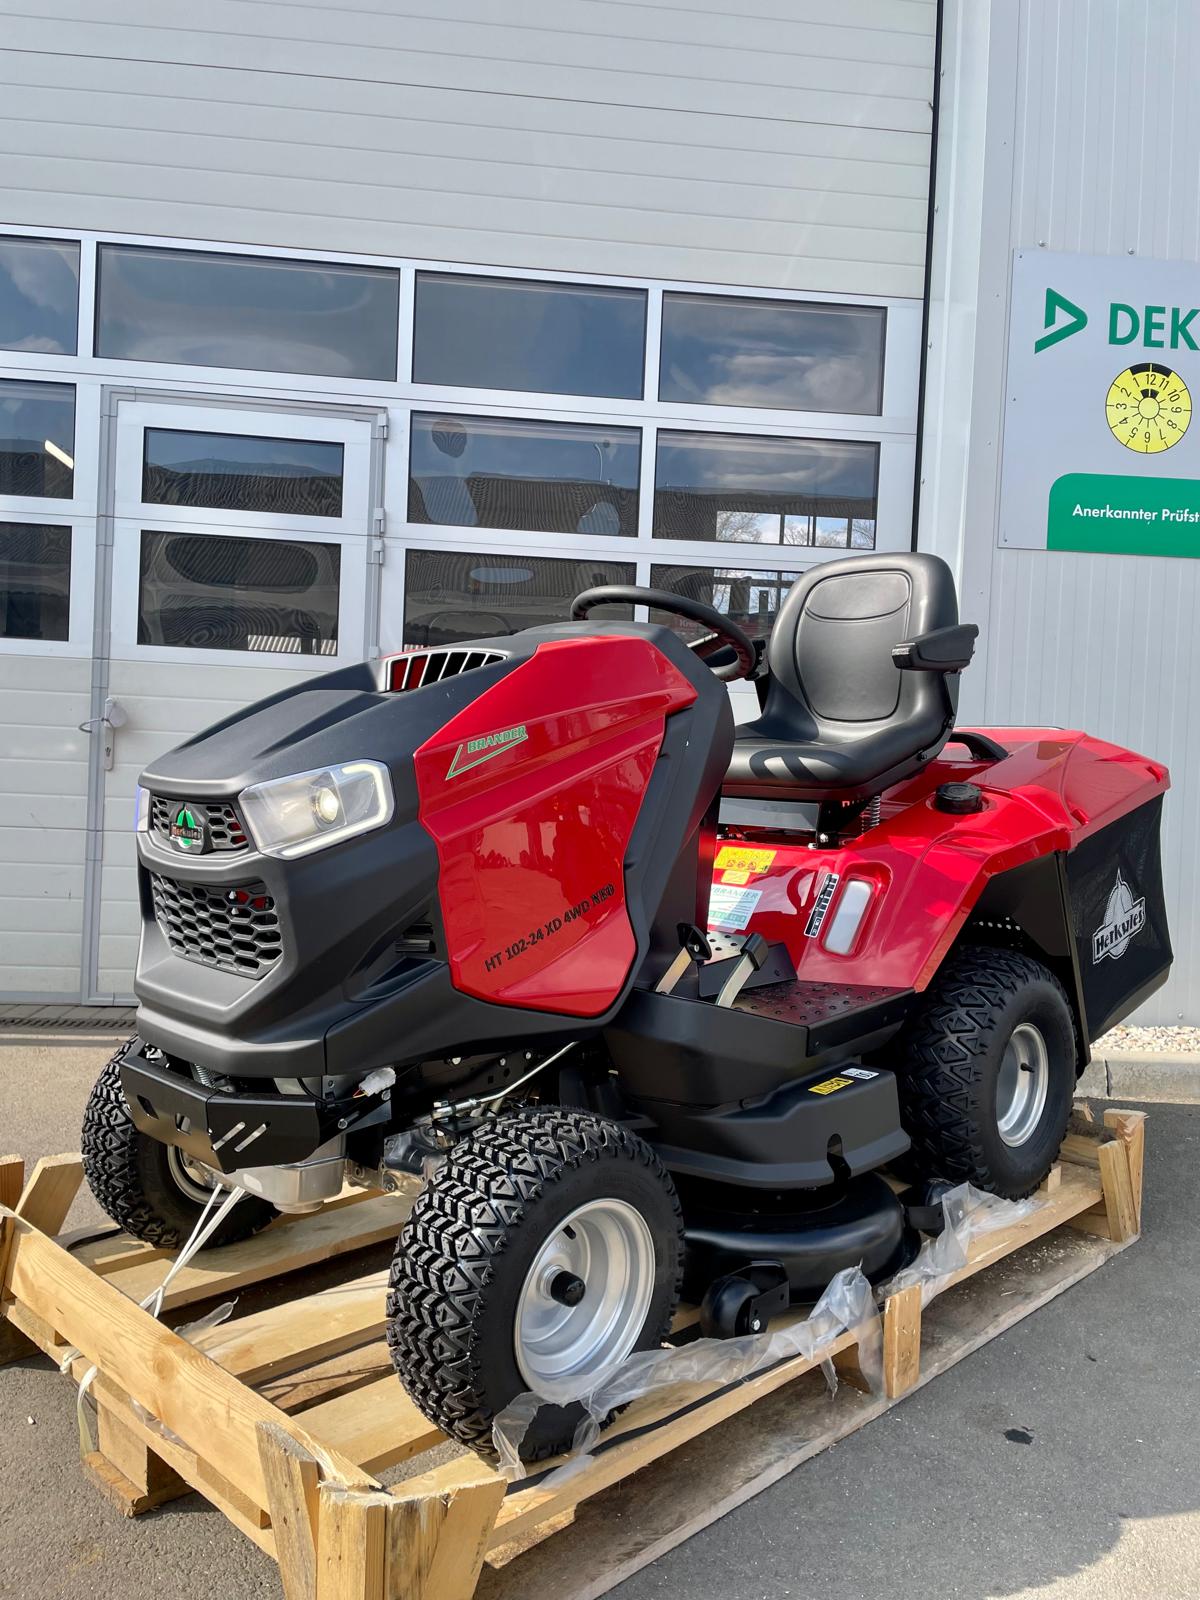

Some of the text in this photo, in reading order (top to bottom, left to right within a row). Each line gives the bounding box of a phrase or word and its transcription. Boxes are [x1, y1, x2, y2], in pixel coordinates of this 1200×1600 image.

[1108, 302, 1200, 351] DEK
[1132, 376, 1140, 388] 1
[1145, 373, 1157, 386] 12
[1158, 377, 1170, 391] 11
[1120, 387, 1132, 398] 2
[1167, 388, 1181, 403] 10
[1115, 402, 1128, 410] 3
[1118, 416, 1129, 425] 4
[1166, 419, 1178, 430] 8
[1128, 426, 1139, 439] 5
[1158, 428, 1167, 441] 7
[1072, 503, 1158, 521] Anerkannter
[467, 725, 527, 754] BRANDER
[1095, 903, 1143, 955] Herkules
[484, 951, 503, 973] HT
[504, 927, 545, 961] 102-24
[544, 917, 563, 937] XD
[564, 900, 590, 924] 4WD
